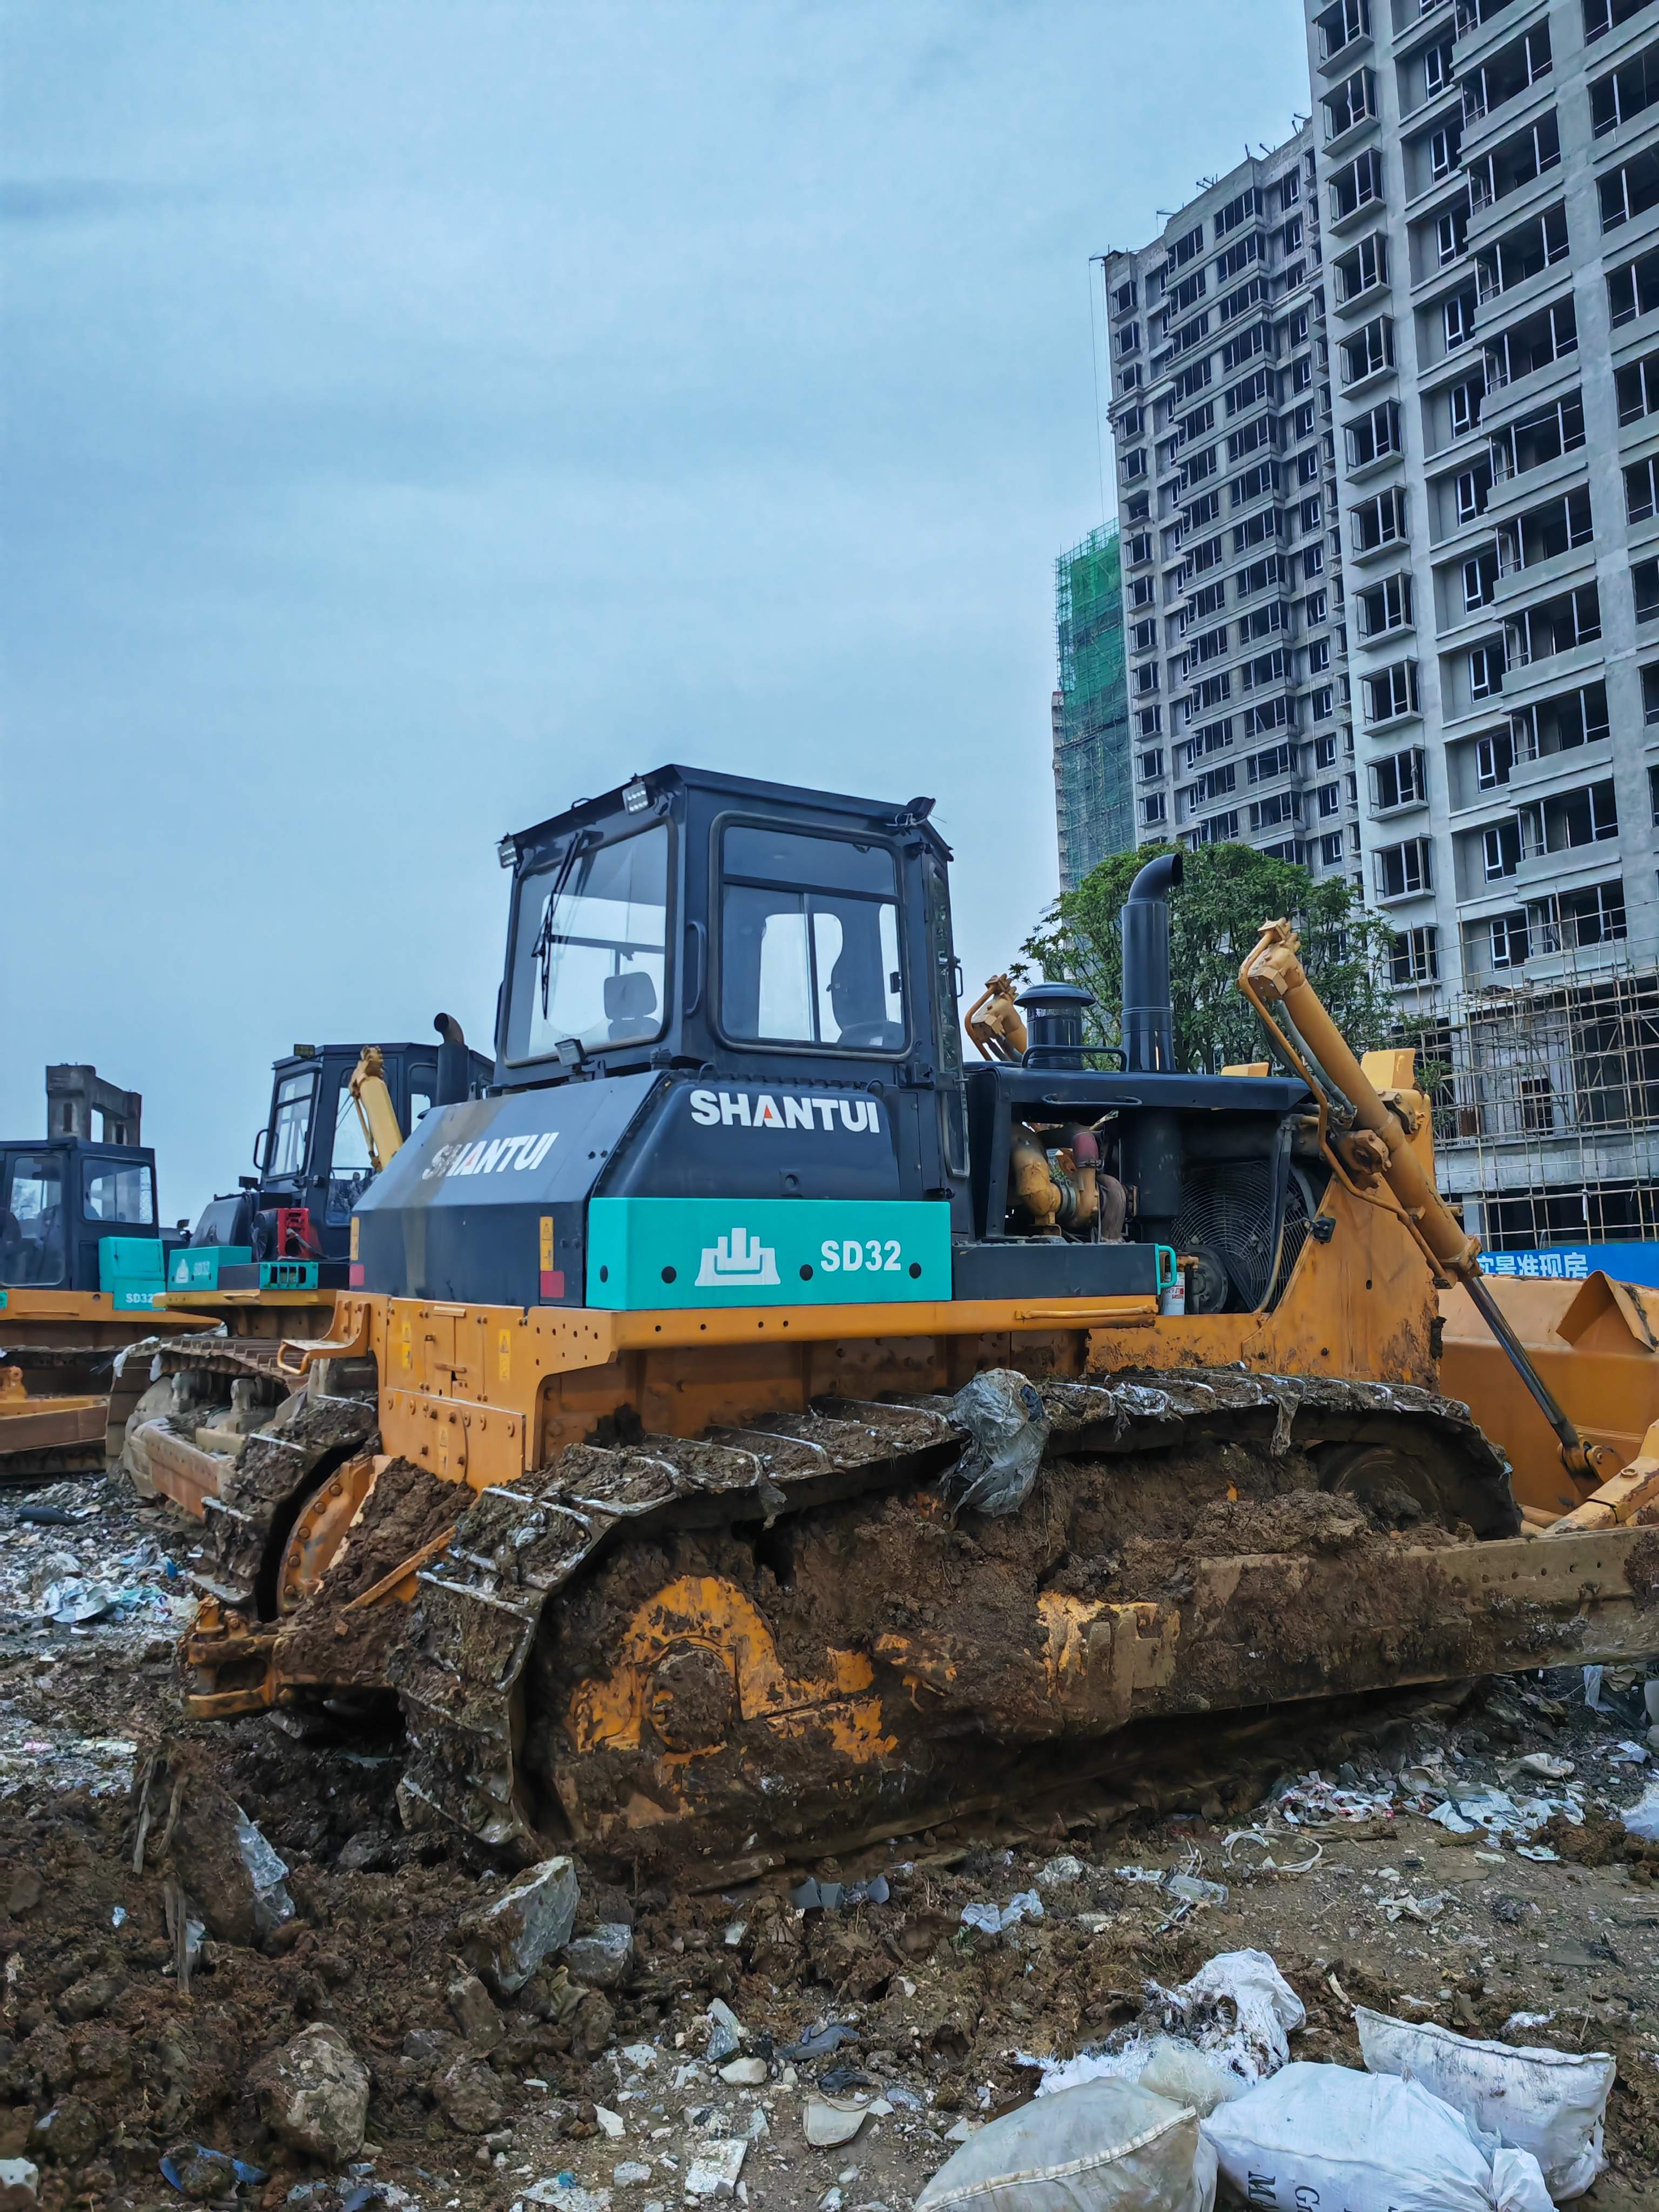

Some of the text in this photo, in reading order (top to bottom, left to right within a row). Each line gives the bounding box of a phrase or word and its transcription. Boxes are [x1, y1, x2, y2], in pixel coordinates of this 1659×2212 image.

[690, 1089, 880, 1134] SHANTUI
[422, 1132, 560, 1180] SHANTUI
[820, 1240, 901, 1272] SD32
